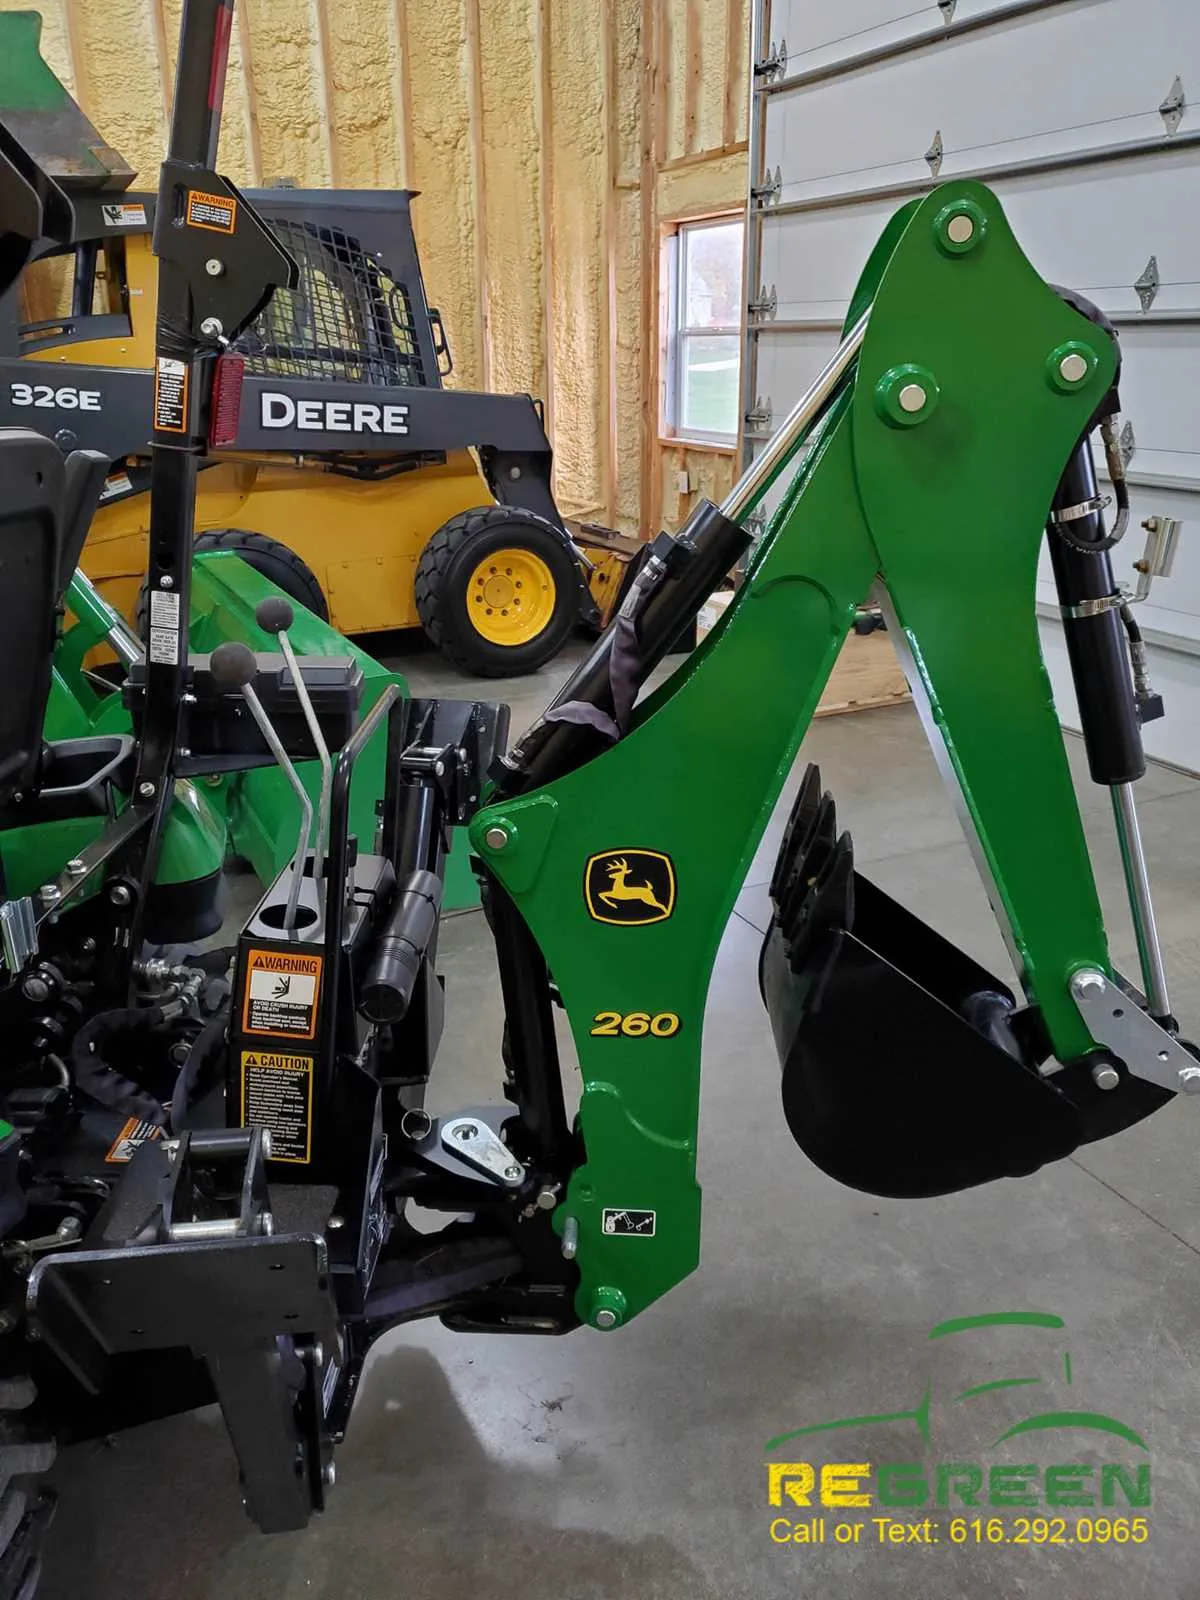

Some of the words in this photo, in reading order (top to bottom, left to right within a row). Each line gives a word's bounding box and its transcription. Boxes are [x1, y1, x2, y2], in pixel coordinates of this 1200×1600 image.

[198, 194, 234, 208] WARNING
[10, 383, 102, 411] 326E
[260, 392, 409, 435] DEERE
[265, 956, 318, 973] WARNING
[590, 1010, 681, 1038] 260
[260, 1055, 310, 1070] CAUTION
